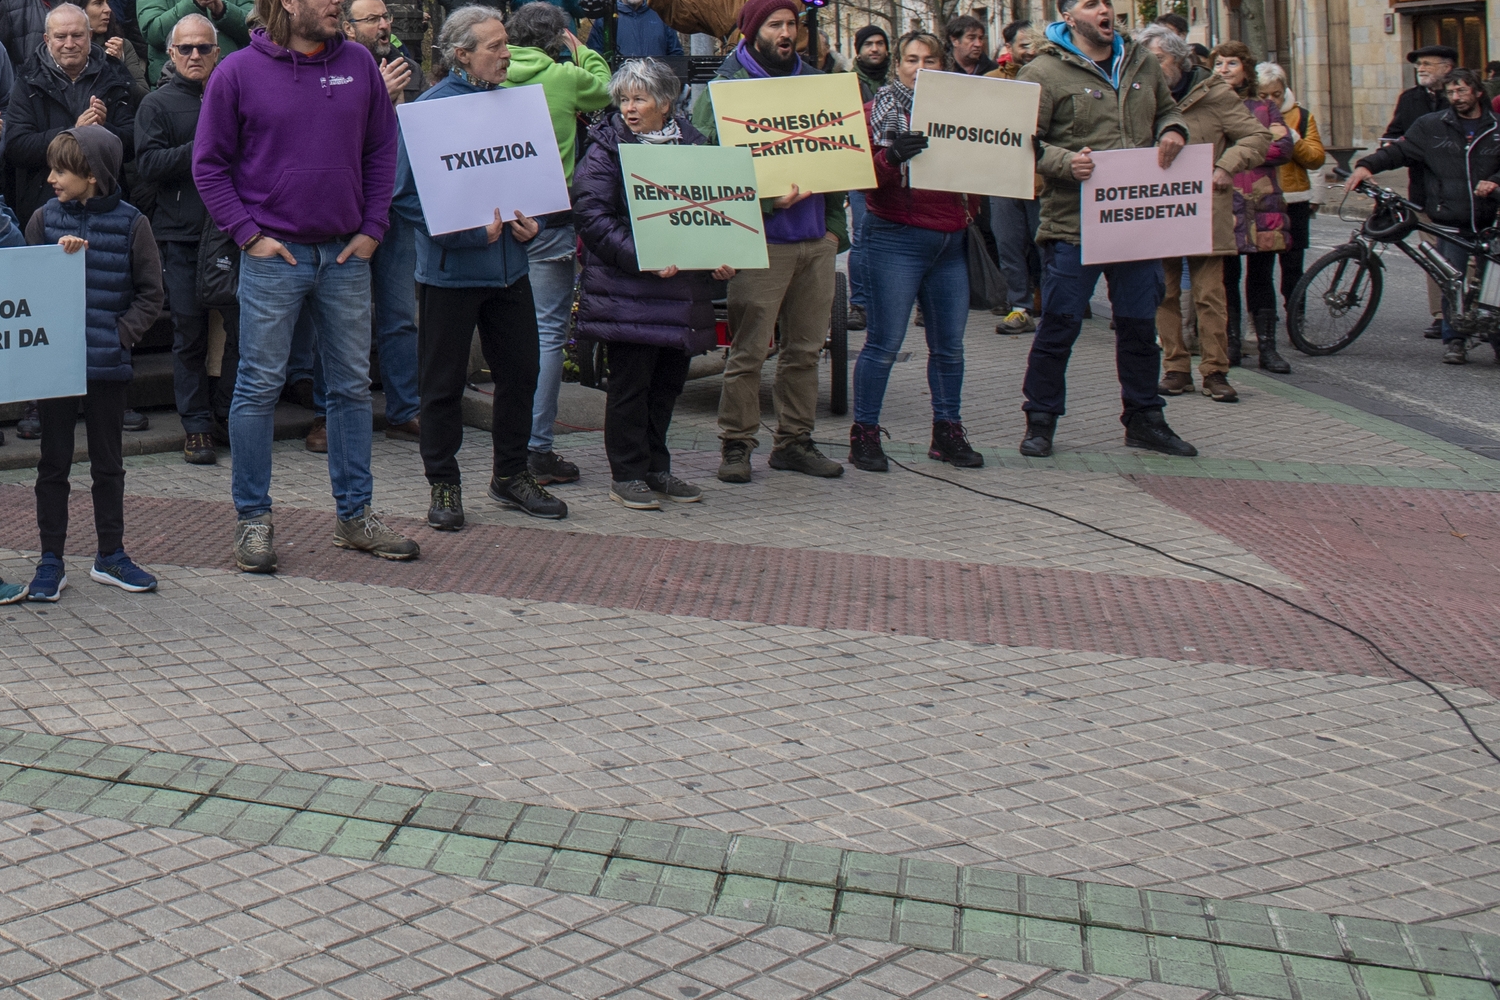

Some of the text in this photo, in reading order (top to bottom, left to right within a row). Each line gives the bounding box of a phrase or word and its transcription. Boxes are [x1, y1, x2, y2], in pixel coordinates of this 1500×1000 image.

[745, 110, 844, 134] COHESIÓN
[927, 121, 1023, 147] IMPOSICIÓN
[440, 141, 538, 171] TXIKIZIOA
[735, 134, 861, 158] ERRITORIAL
[633, 184, 756, 202] RENTABILIDAD
[1095, 180, 1203, 202] BOTEREAREN
[669, 210, 732, 226] SOCIAL
[1100, 202, 1197, 223] MESEDETAN
[18, 327, 50, 348] DA
